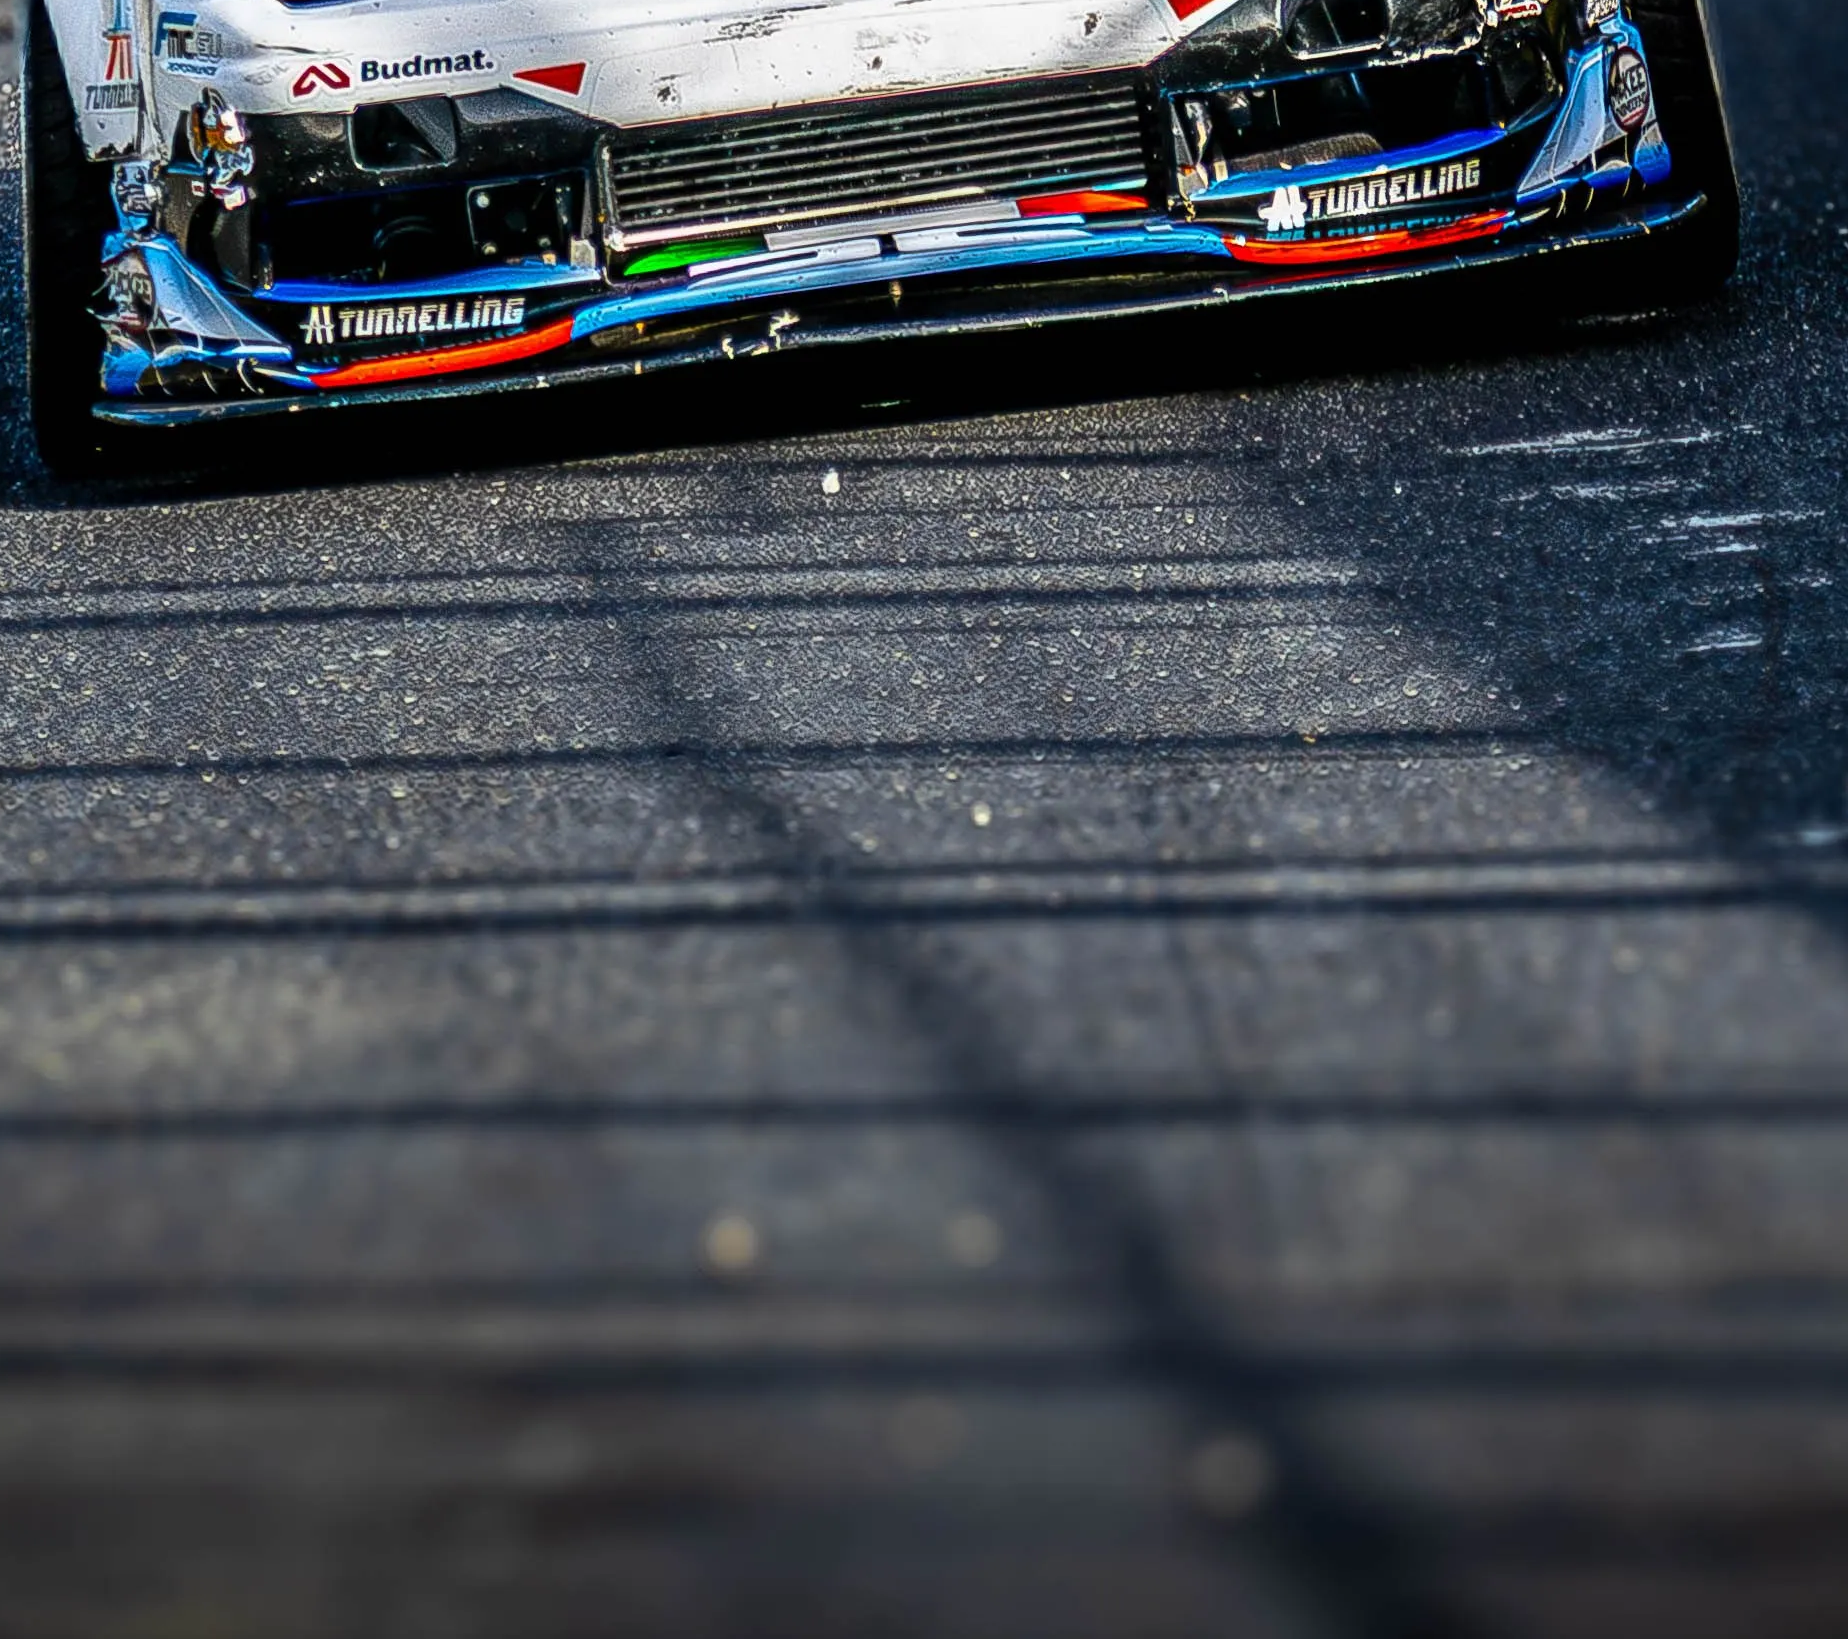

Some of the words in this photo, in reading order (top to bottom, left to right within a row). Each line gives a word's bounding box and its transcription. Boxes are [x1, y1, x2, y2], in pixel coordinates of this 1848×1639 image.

[361, 49, 494, 82] Budmat.
[1308, 158, 1481, 220] TUNNELLING
[339, 297, 527, 338] TUNNELLING
